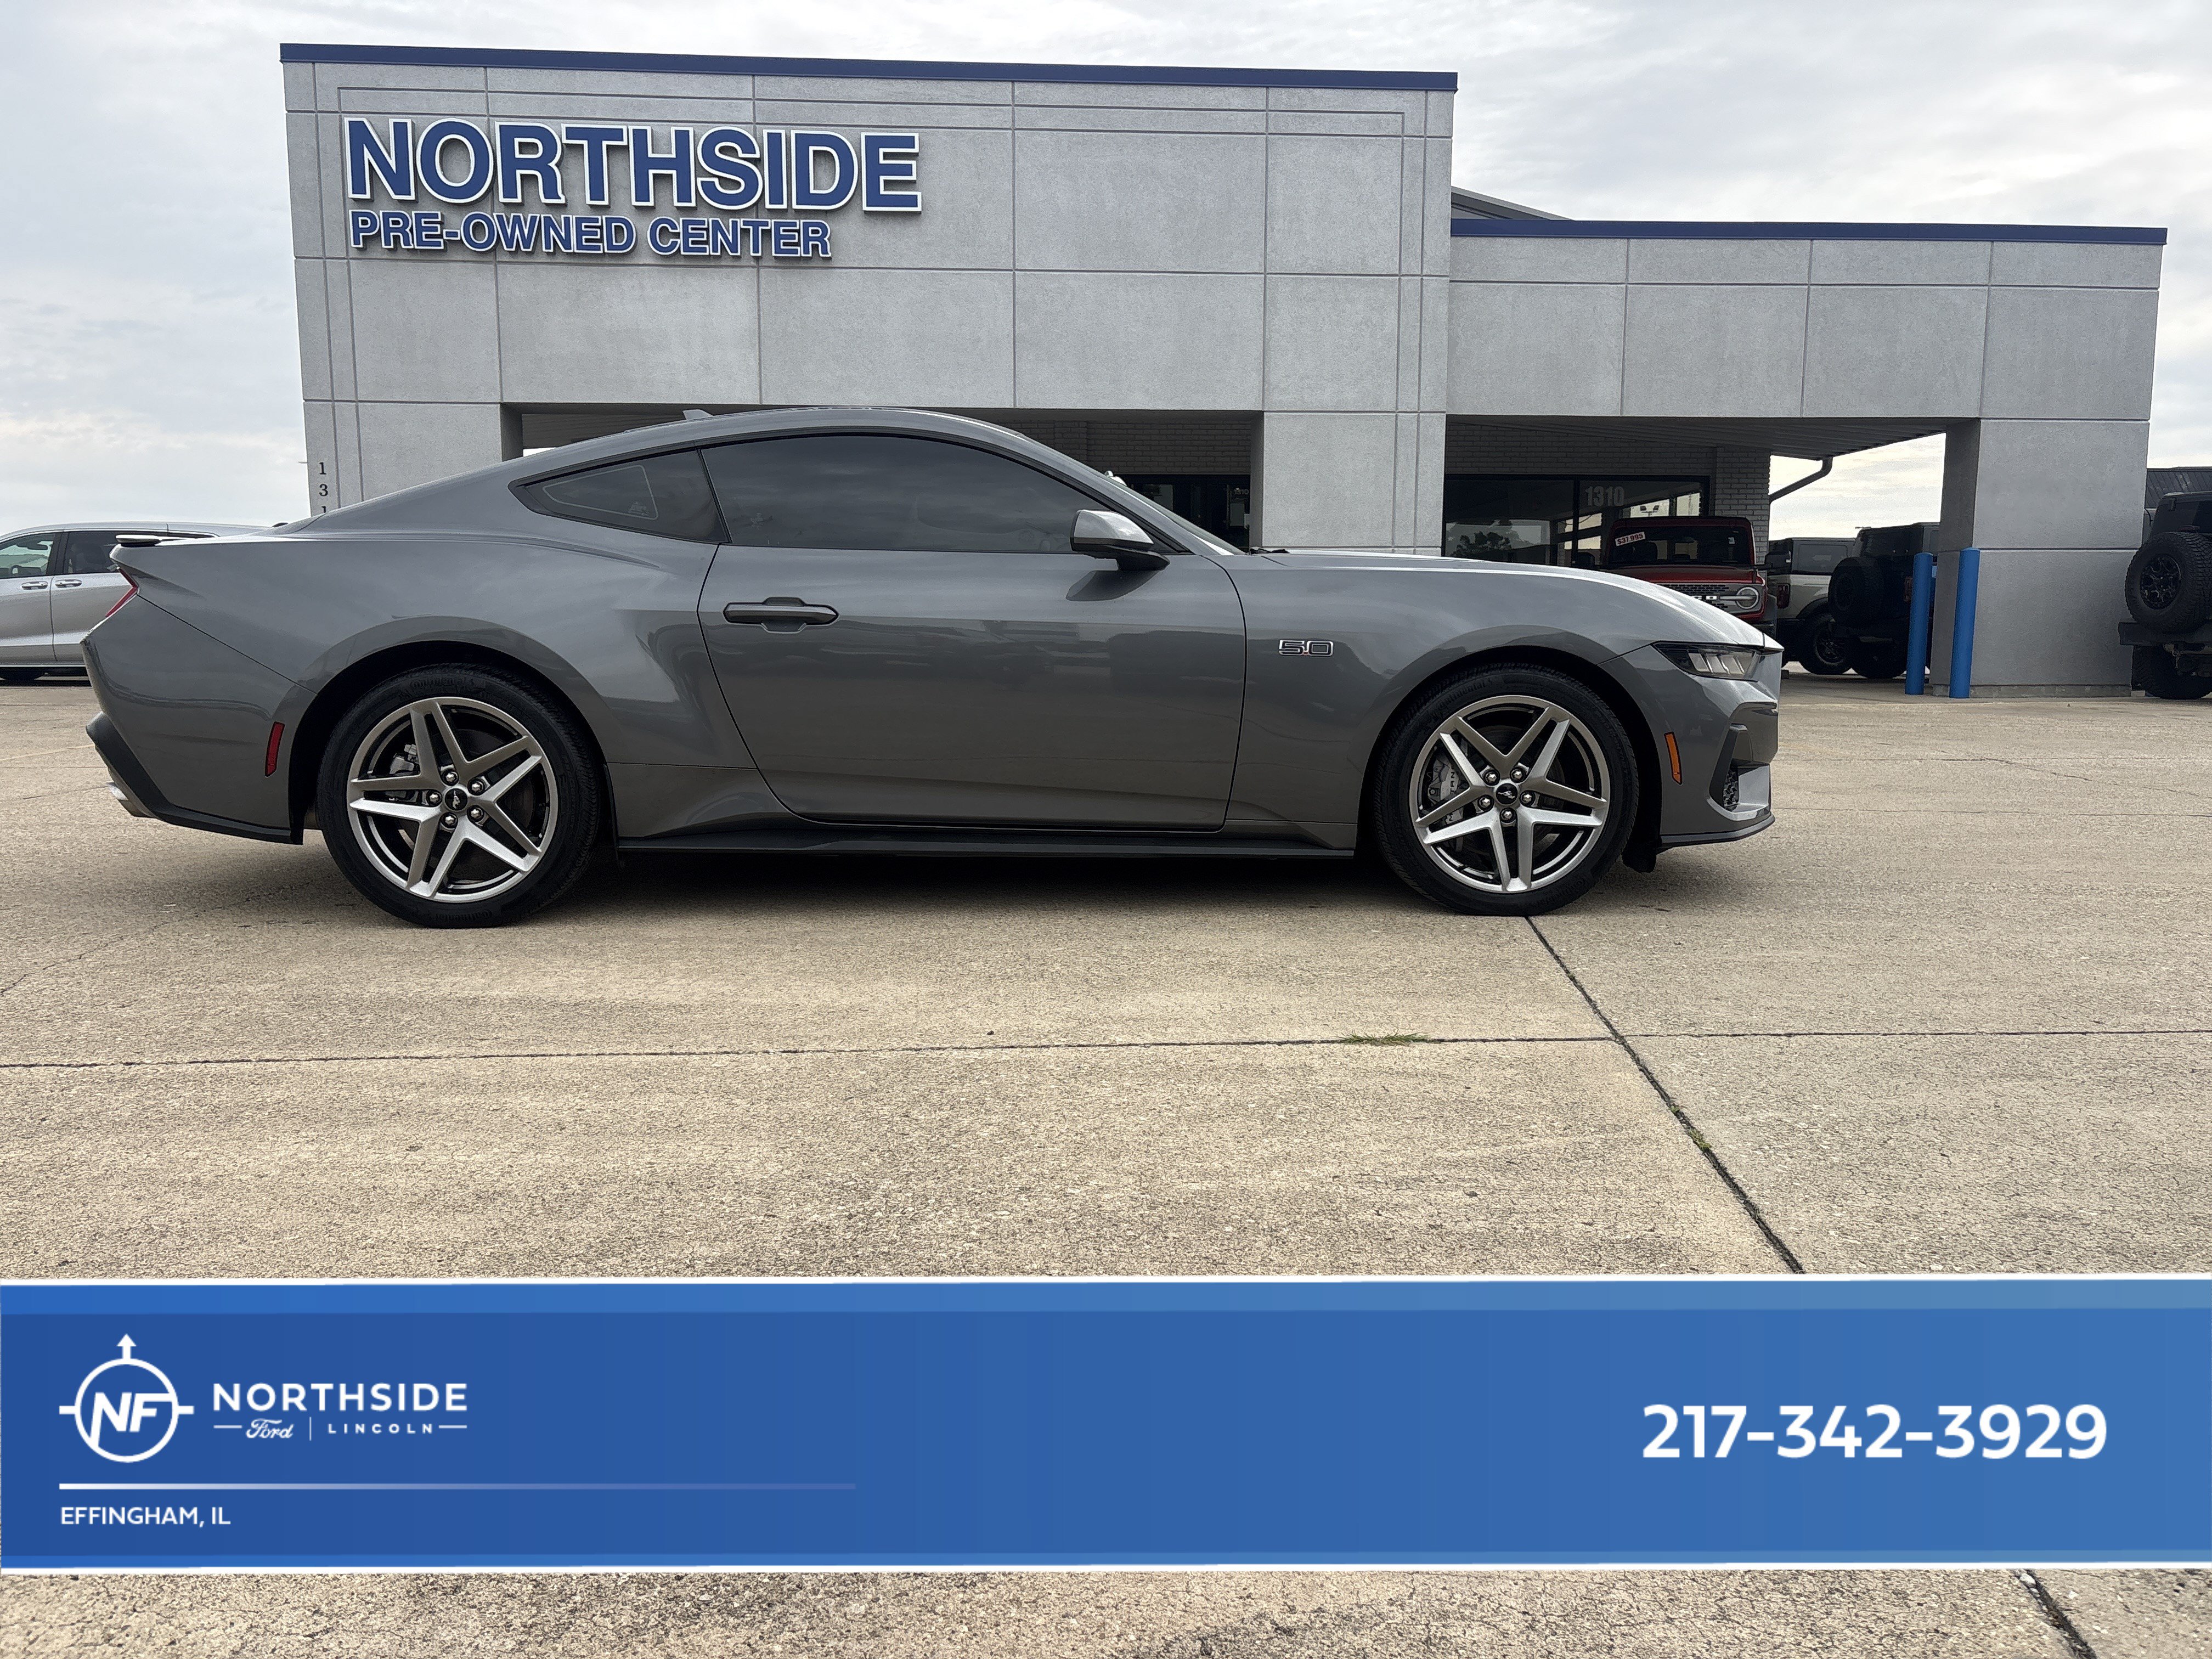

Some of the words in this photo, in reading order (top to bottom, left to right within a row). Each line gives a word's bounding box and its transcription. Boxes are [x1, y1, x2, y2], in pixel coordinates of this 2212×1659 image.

[344, 116, 922, 213] NORTHSIDE
[348, 209, 636, 255] PRE-OWNED
[647, 216, 833, 260] CENTER
[1585, 486, 1624, 506] 1310
[1278, 640, 1334, 657] 5.0
